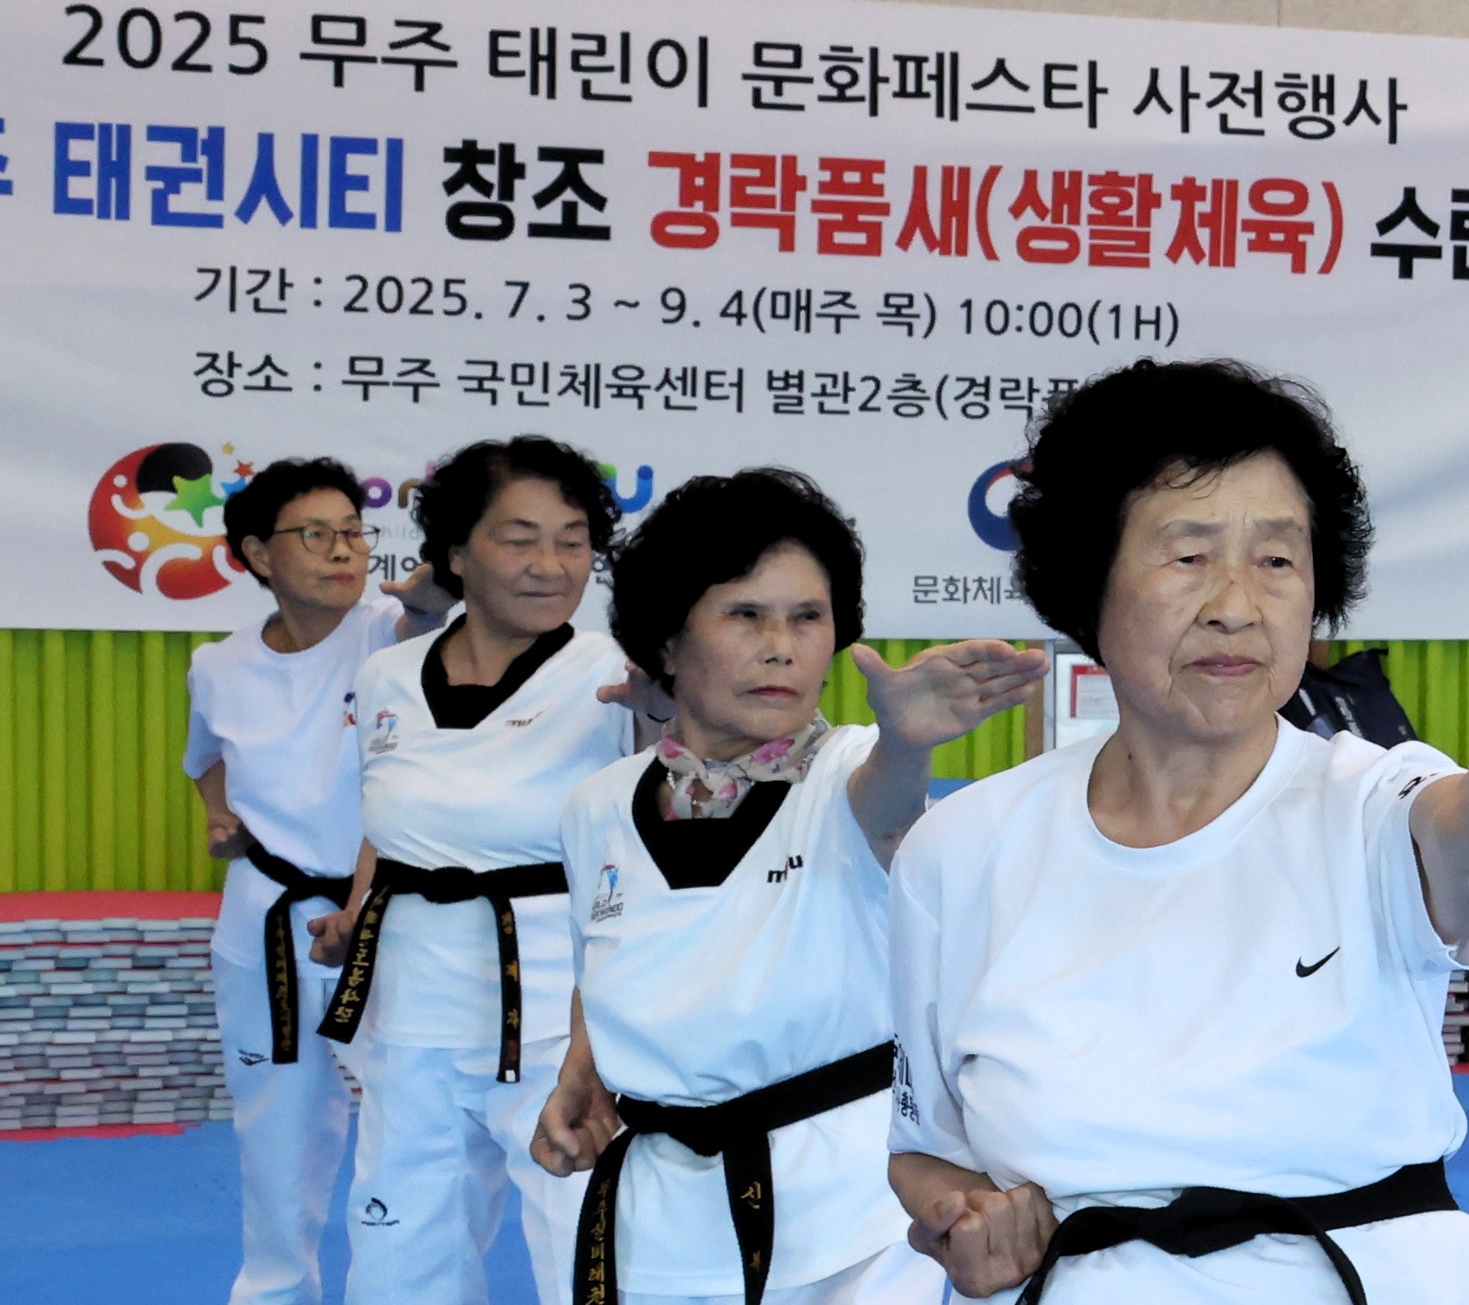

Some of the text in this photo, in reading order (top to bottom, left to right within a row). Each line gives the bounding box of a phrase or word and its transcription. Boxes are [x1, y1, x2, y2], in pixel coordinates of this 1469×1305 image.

[62, 3, 1408, 145] 2025 무주 태린이 문화페스타 사전행사
[51, 120, 405, 234] 태권시티
[441, 139, 612, 242] 창조
[646, 151, 1345, 275] 경락품새(생활체육)
[194, 266, 294, 315] 기간
[343, 275, 484, 319] 2025.
[566, 283, 592, 322] 3
[718, 288, 860, 336] 4(매주
[876, 292, 938, 340] 목)
[963, 299, 1181, 348] 10:00(1H)
[193, 350, 294, 397] 장소
[341, 356, 441, 404] 무주
[456, 360, 744, 413] 국민체육센터
